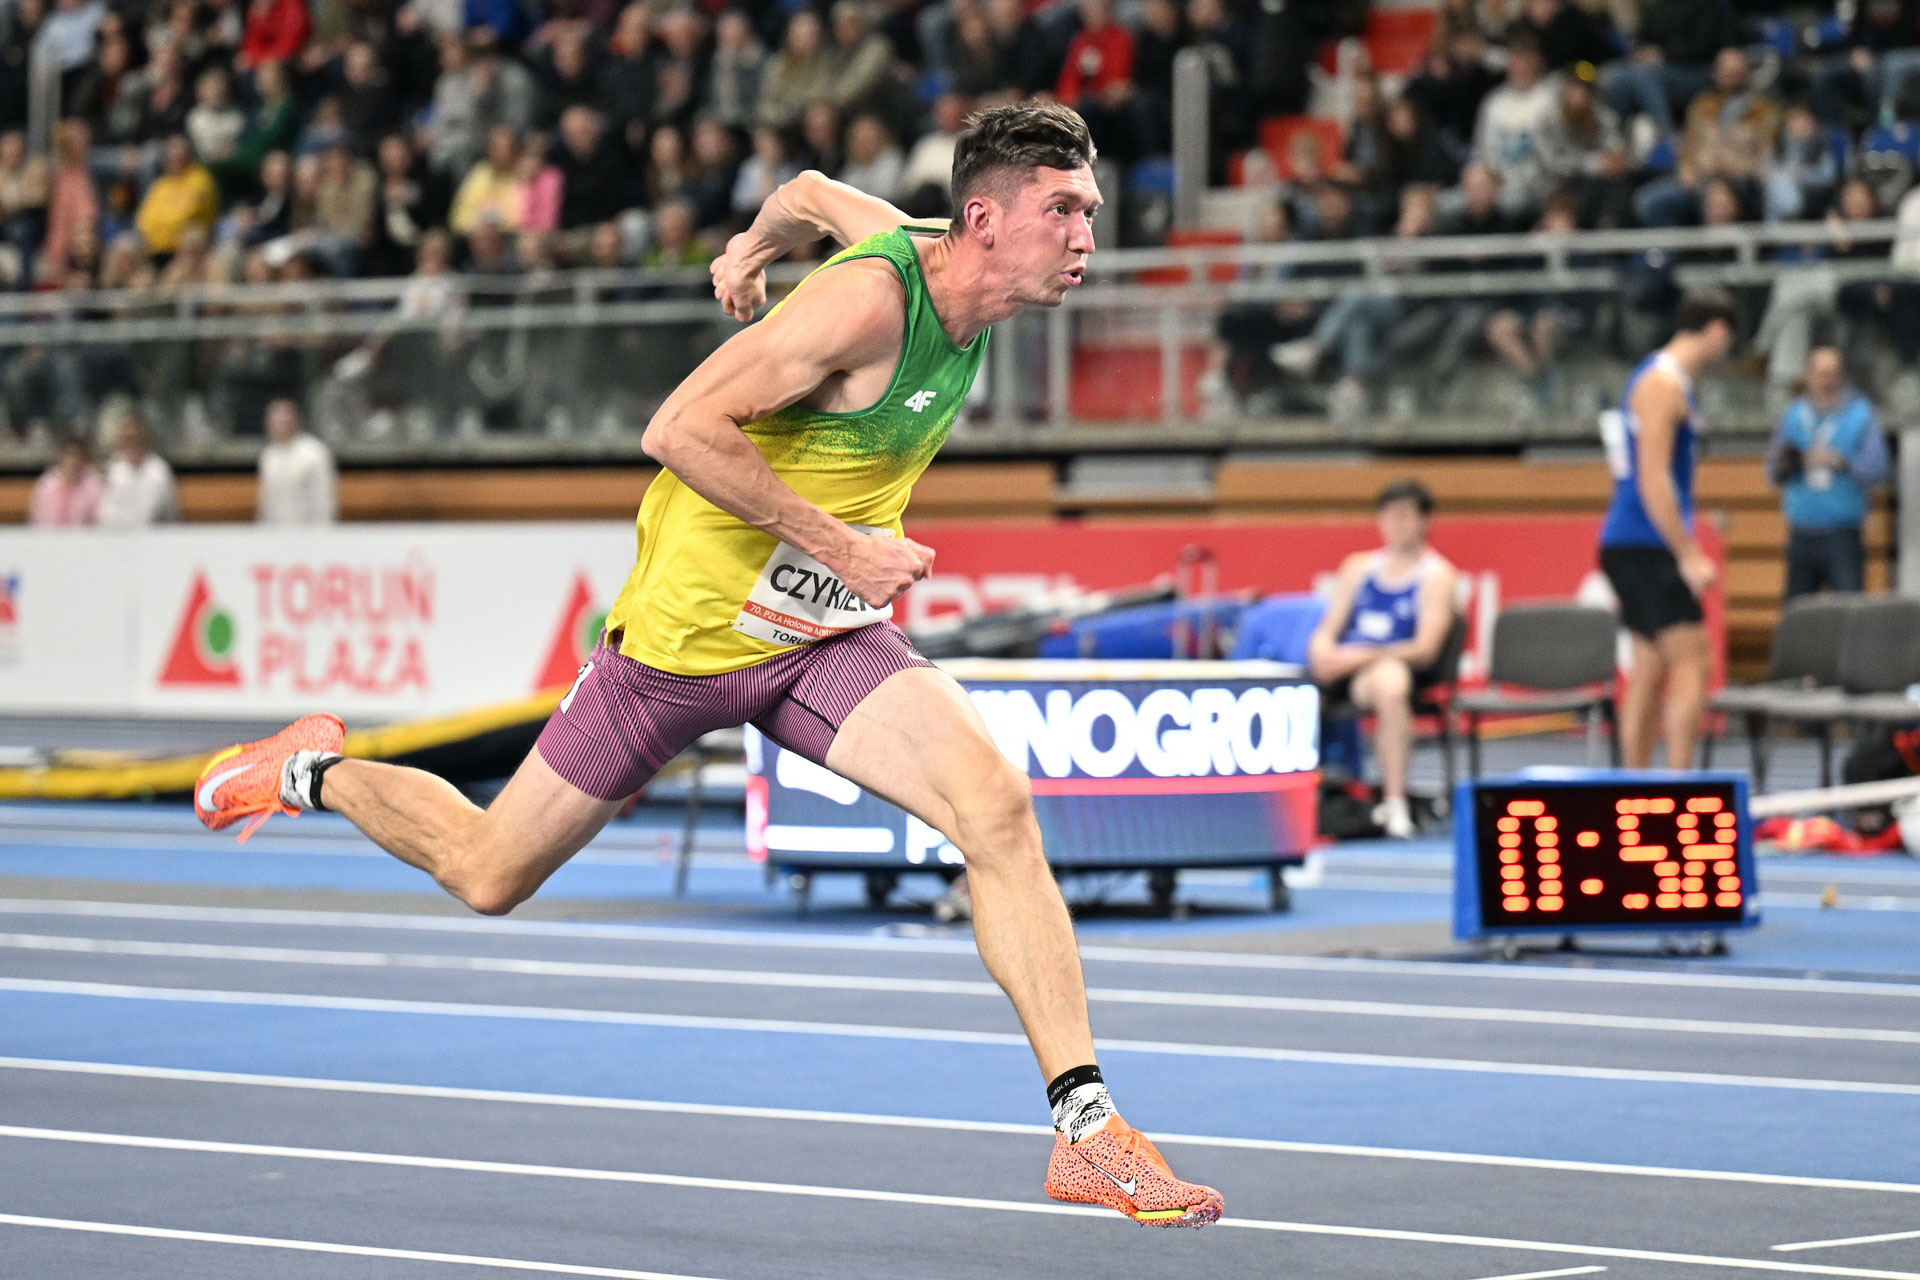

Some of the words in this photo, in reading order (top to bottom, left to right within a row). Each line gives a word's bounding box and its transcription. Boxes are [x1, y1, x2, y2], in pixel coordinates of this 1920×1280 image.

[904, 390, 937, 413] 4F
[750, 604, 762, 615] 70.
[764, 610, 782, 623] PZLA
[783, 618, 814, 633] Halowe
[258, 632, 431, 694] PLAZA
